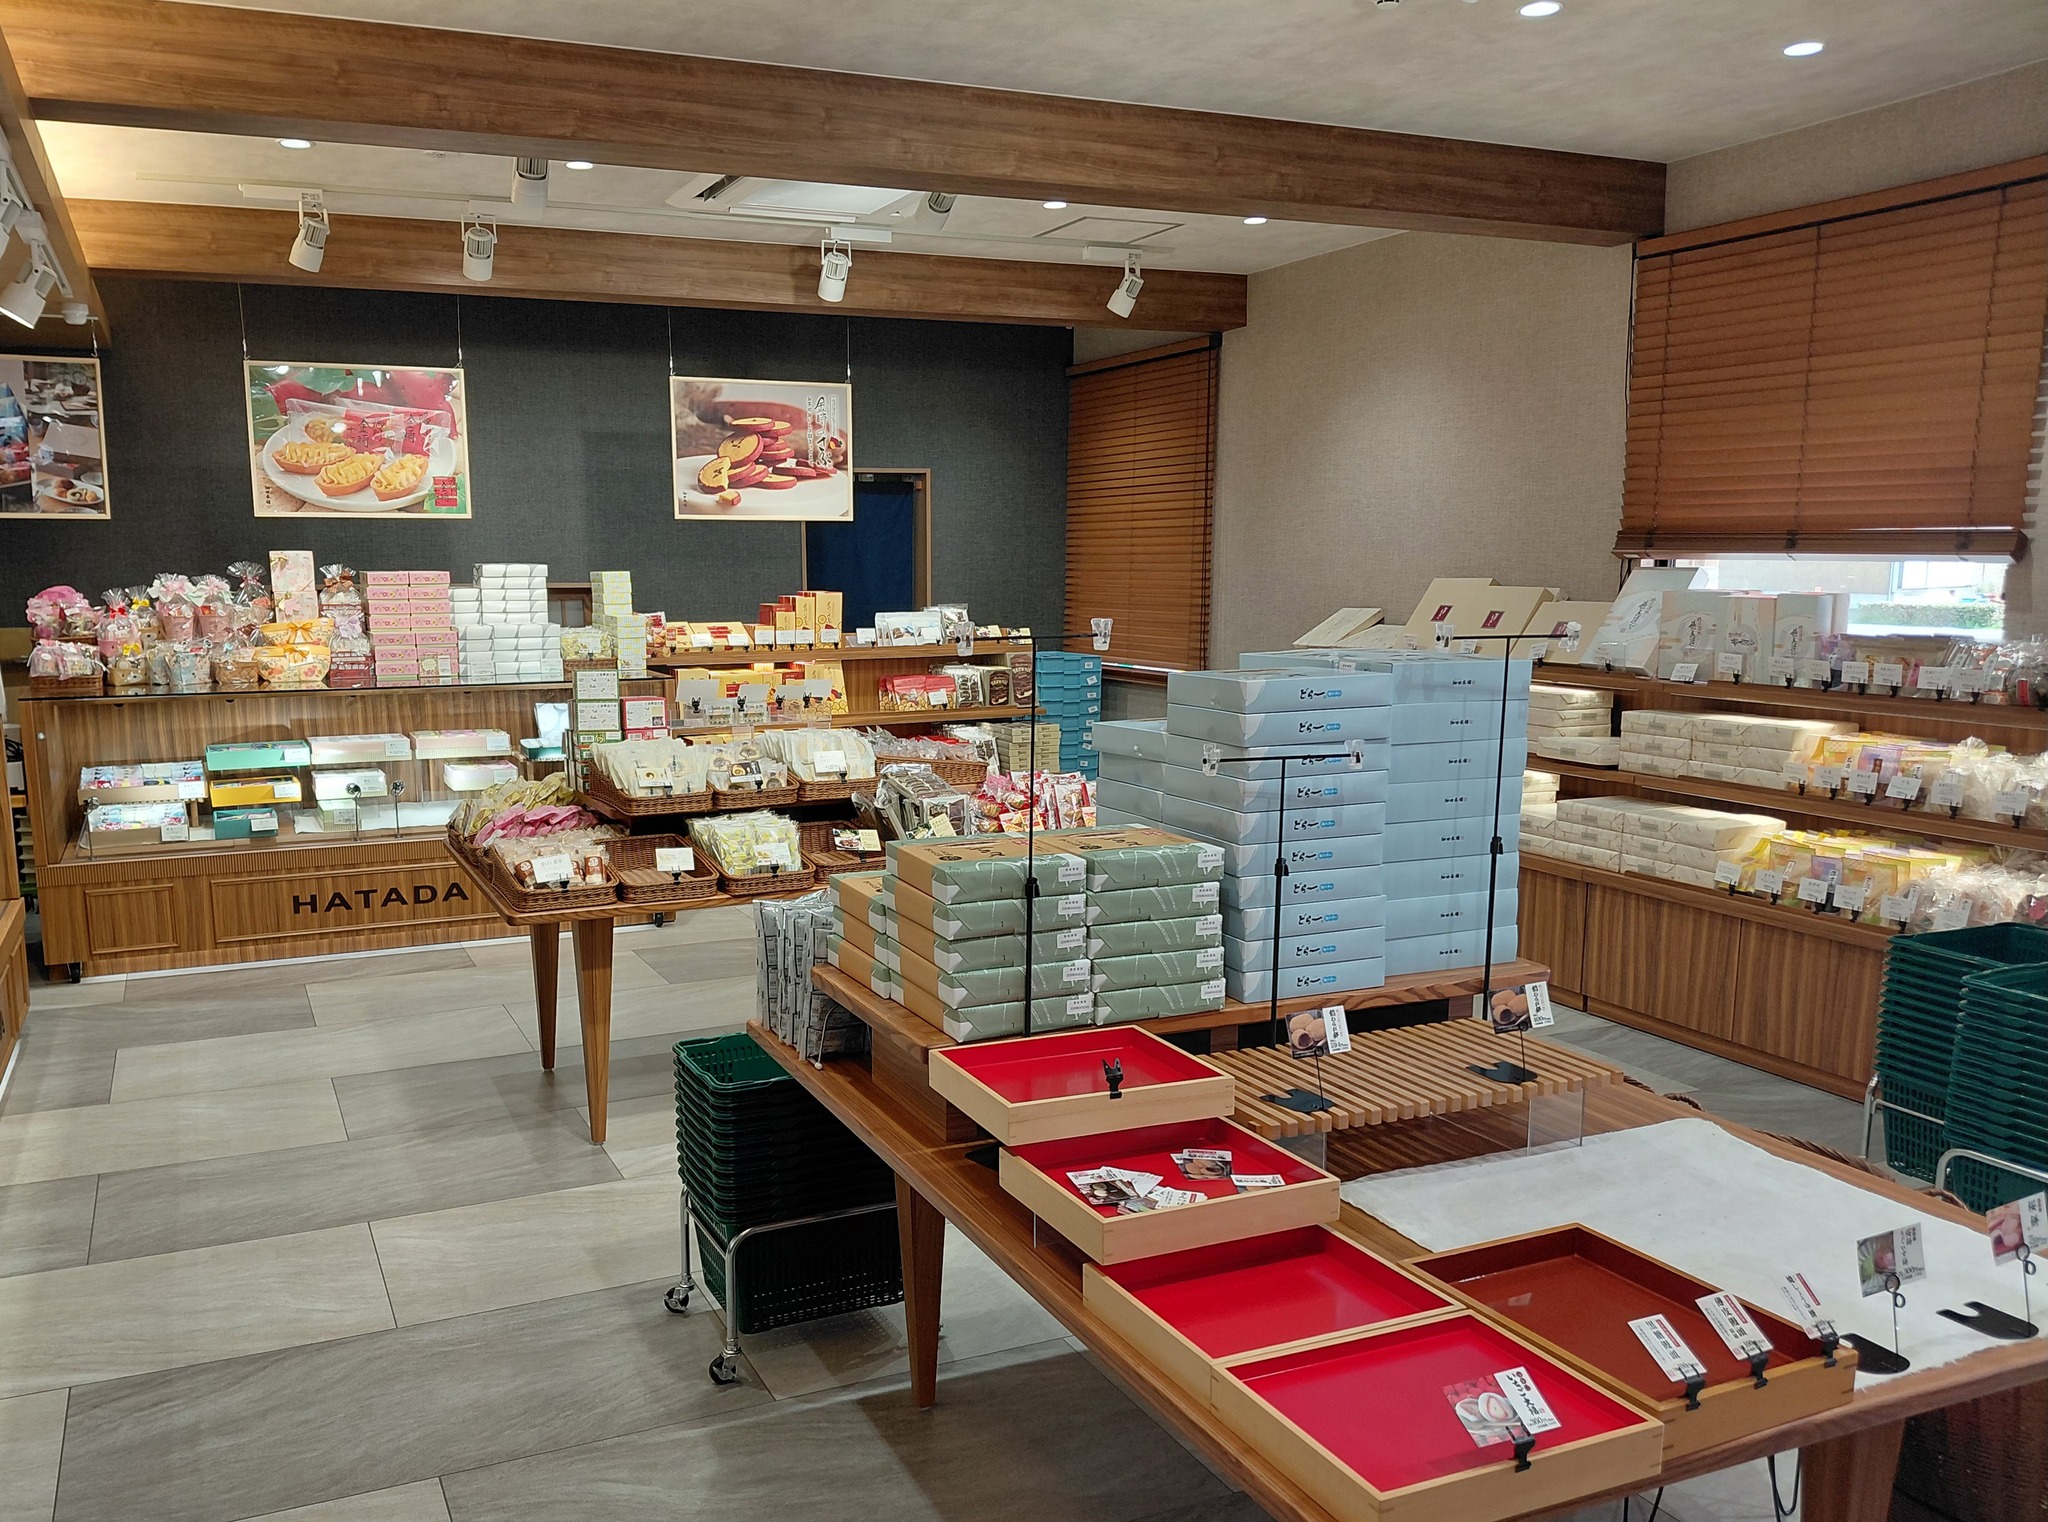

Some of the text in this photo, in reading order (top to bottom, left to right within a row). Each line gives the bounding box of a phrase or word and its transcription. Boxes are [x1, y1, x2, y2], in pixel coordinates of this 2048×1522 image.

[292, 882, 469, 915] HATADA
[1506, 1373, 1540, 1417] いちご大福
